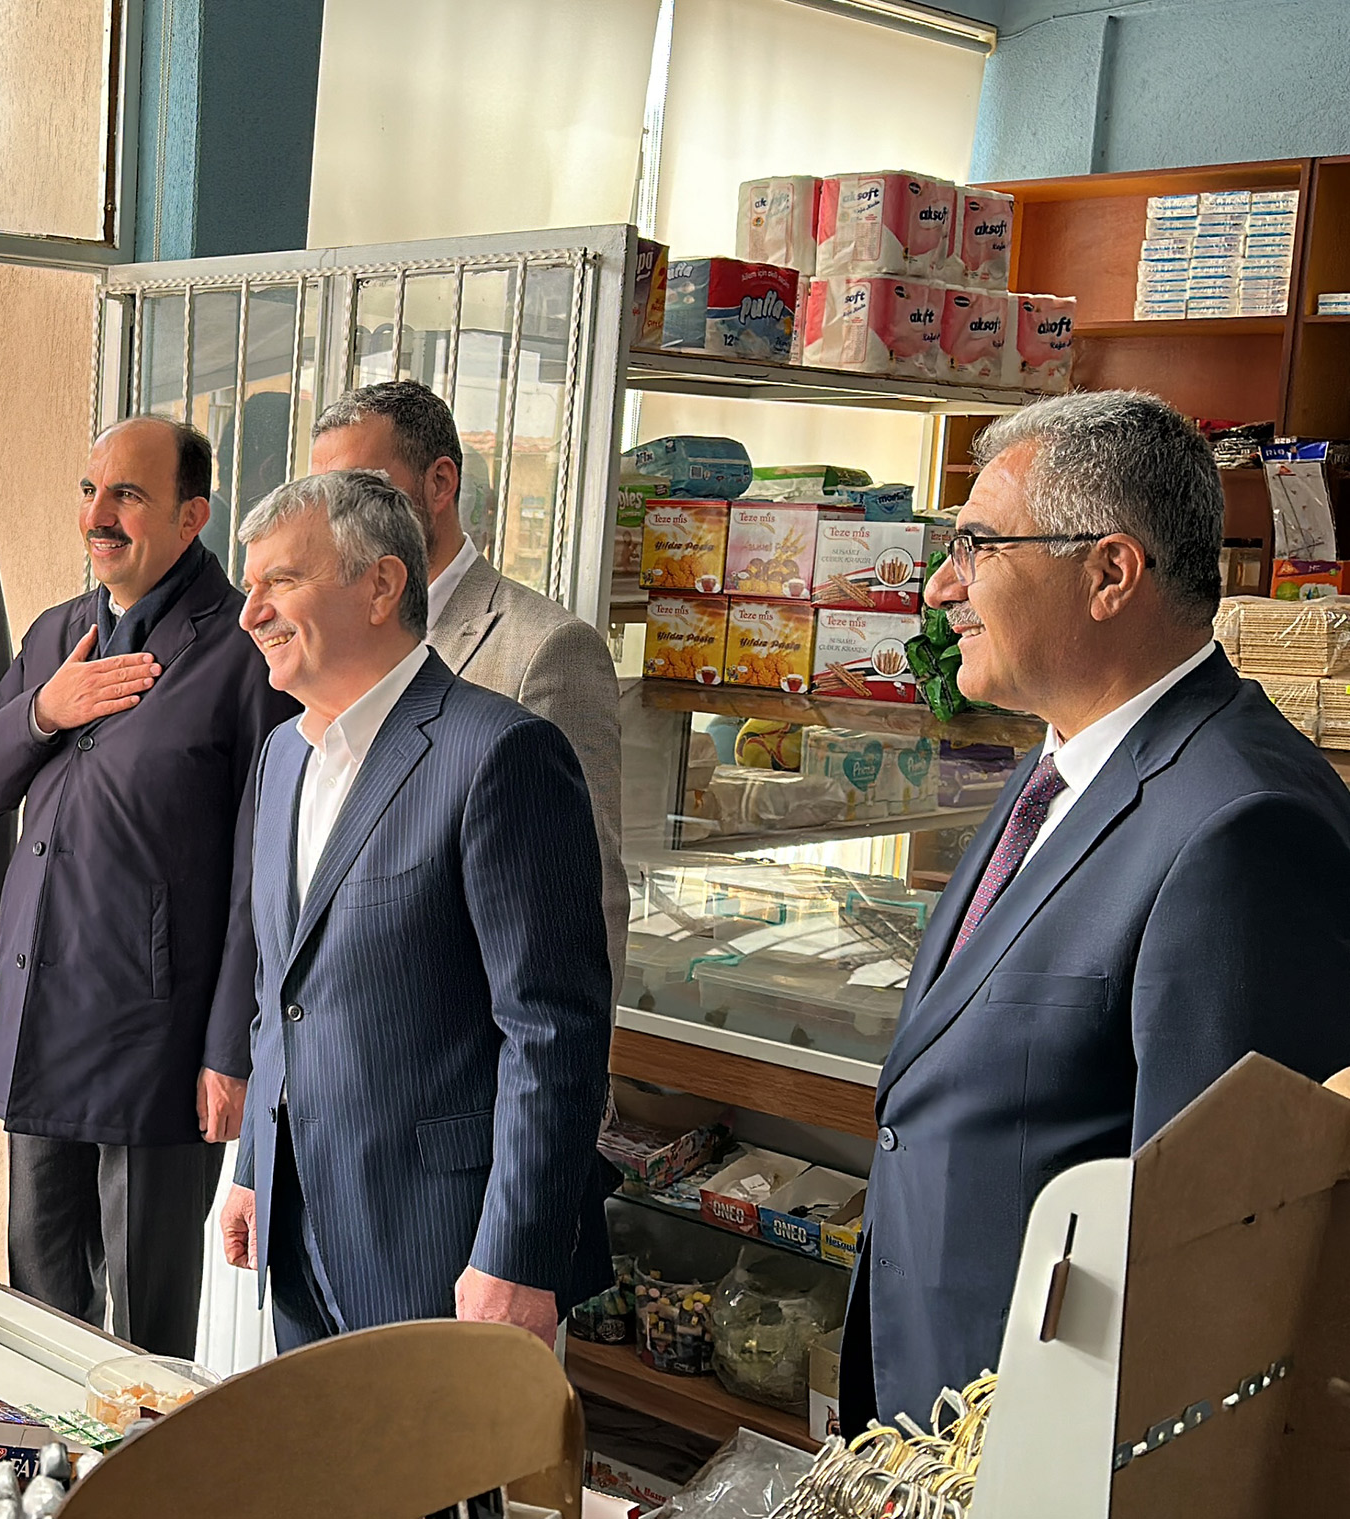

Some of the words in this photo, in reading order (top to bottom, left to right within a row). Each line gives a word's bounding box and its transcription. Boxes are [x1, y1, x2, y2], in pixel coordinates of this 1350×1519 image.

[739, 290, 784, 325] puffa
[739, 512, 757, 522] Teze
[830, 526, 850, 537] Teze
[739, 609, 757, 620] Teze
[826, 616, 847, 626] Teze
[773, 1219, 807, 1243] ONEO
